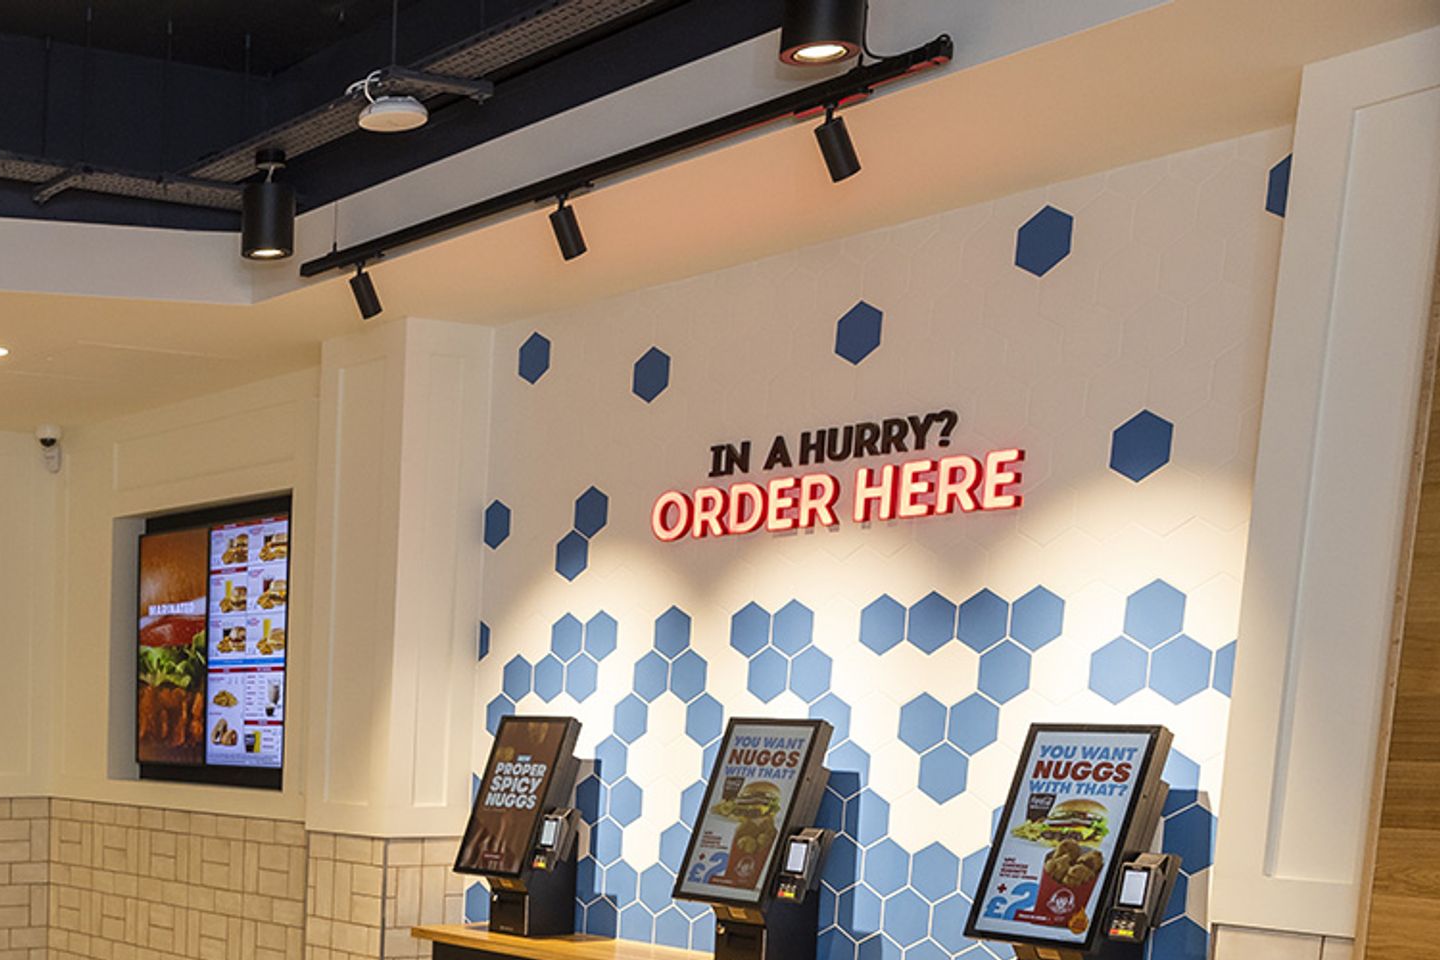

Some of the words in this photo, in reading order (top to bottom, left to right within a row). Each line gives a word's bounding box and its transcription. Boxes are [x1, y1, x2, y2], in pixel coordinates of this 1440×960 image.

[708, 441, 751, 477] IN
[763, 435, 792, 470] A
[799, 410, 959, 466] HURRY?
[651, 473, 840, 541] ORDER
[853, 449, 1026, 523] HERE
[735, 735, 761, 748] YOU
[763, 736, 805, 750] WANT
[728, 748, 801, 768] NUGGS
[1040, 745, 1077, 759] YOU
[1081, 746, 1138, 761] WANT
[495, 761, 547, 777] PROPER
[725, 766, 758, 778] WITH
[759, 768, 797, 780] THAT?
[1032, 760, 1133, 783] NUGGS
[490, 775, 542, 794] SPICY
[1029, 780, 1072, 794] WITH
[1075, 784, 1128, 797] THAT?
[484, 792, 537, 810] NUGGS
[687, 850, 729, 884] £2
[983, 881, 1039, 921] £2
